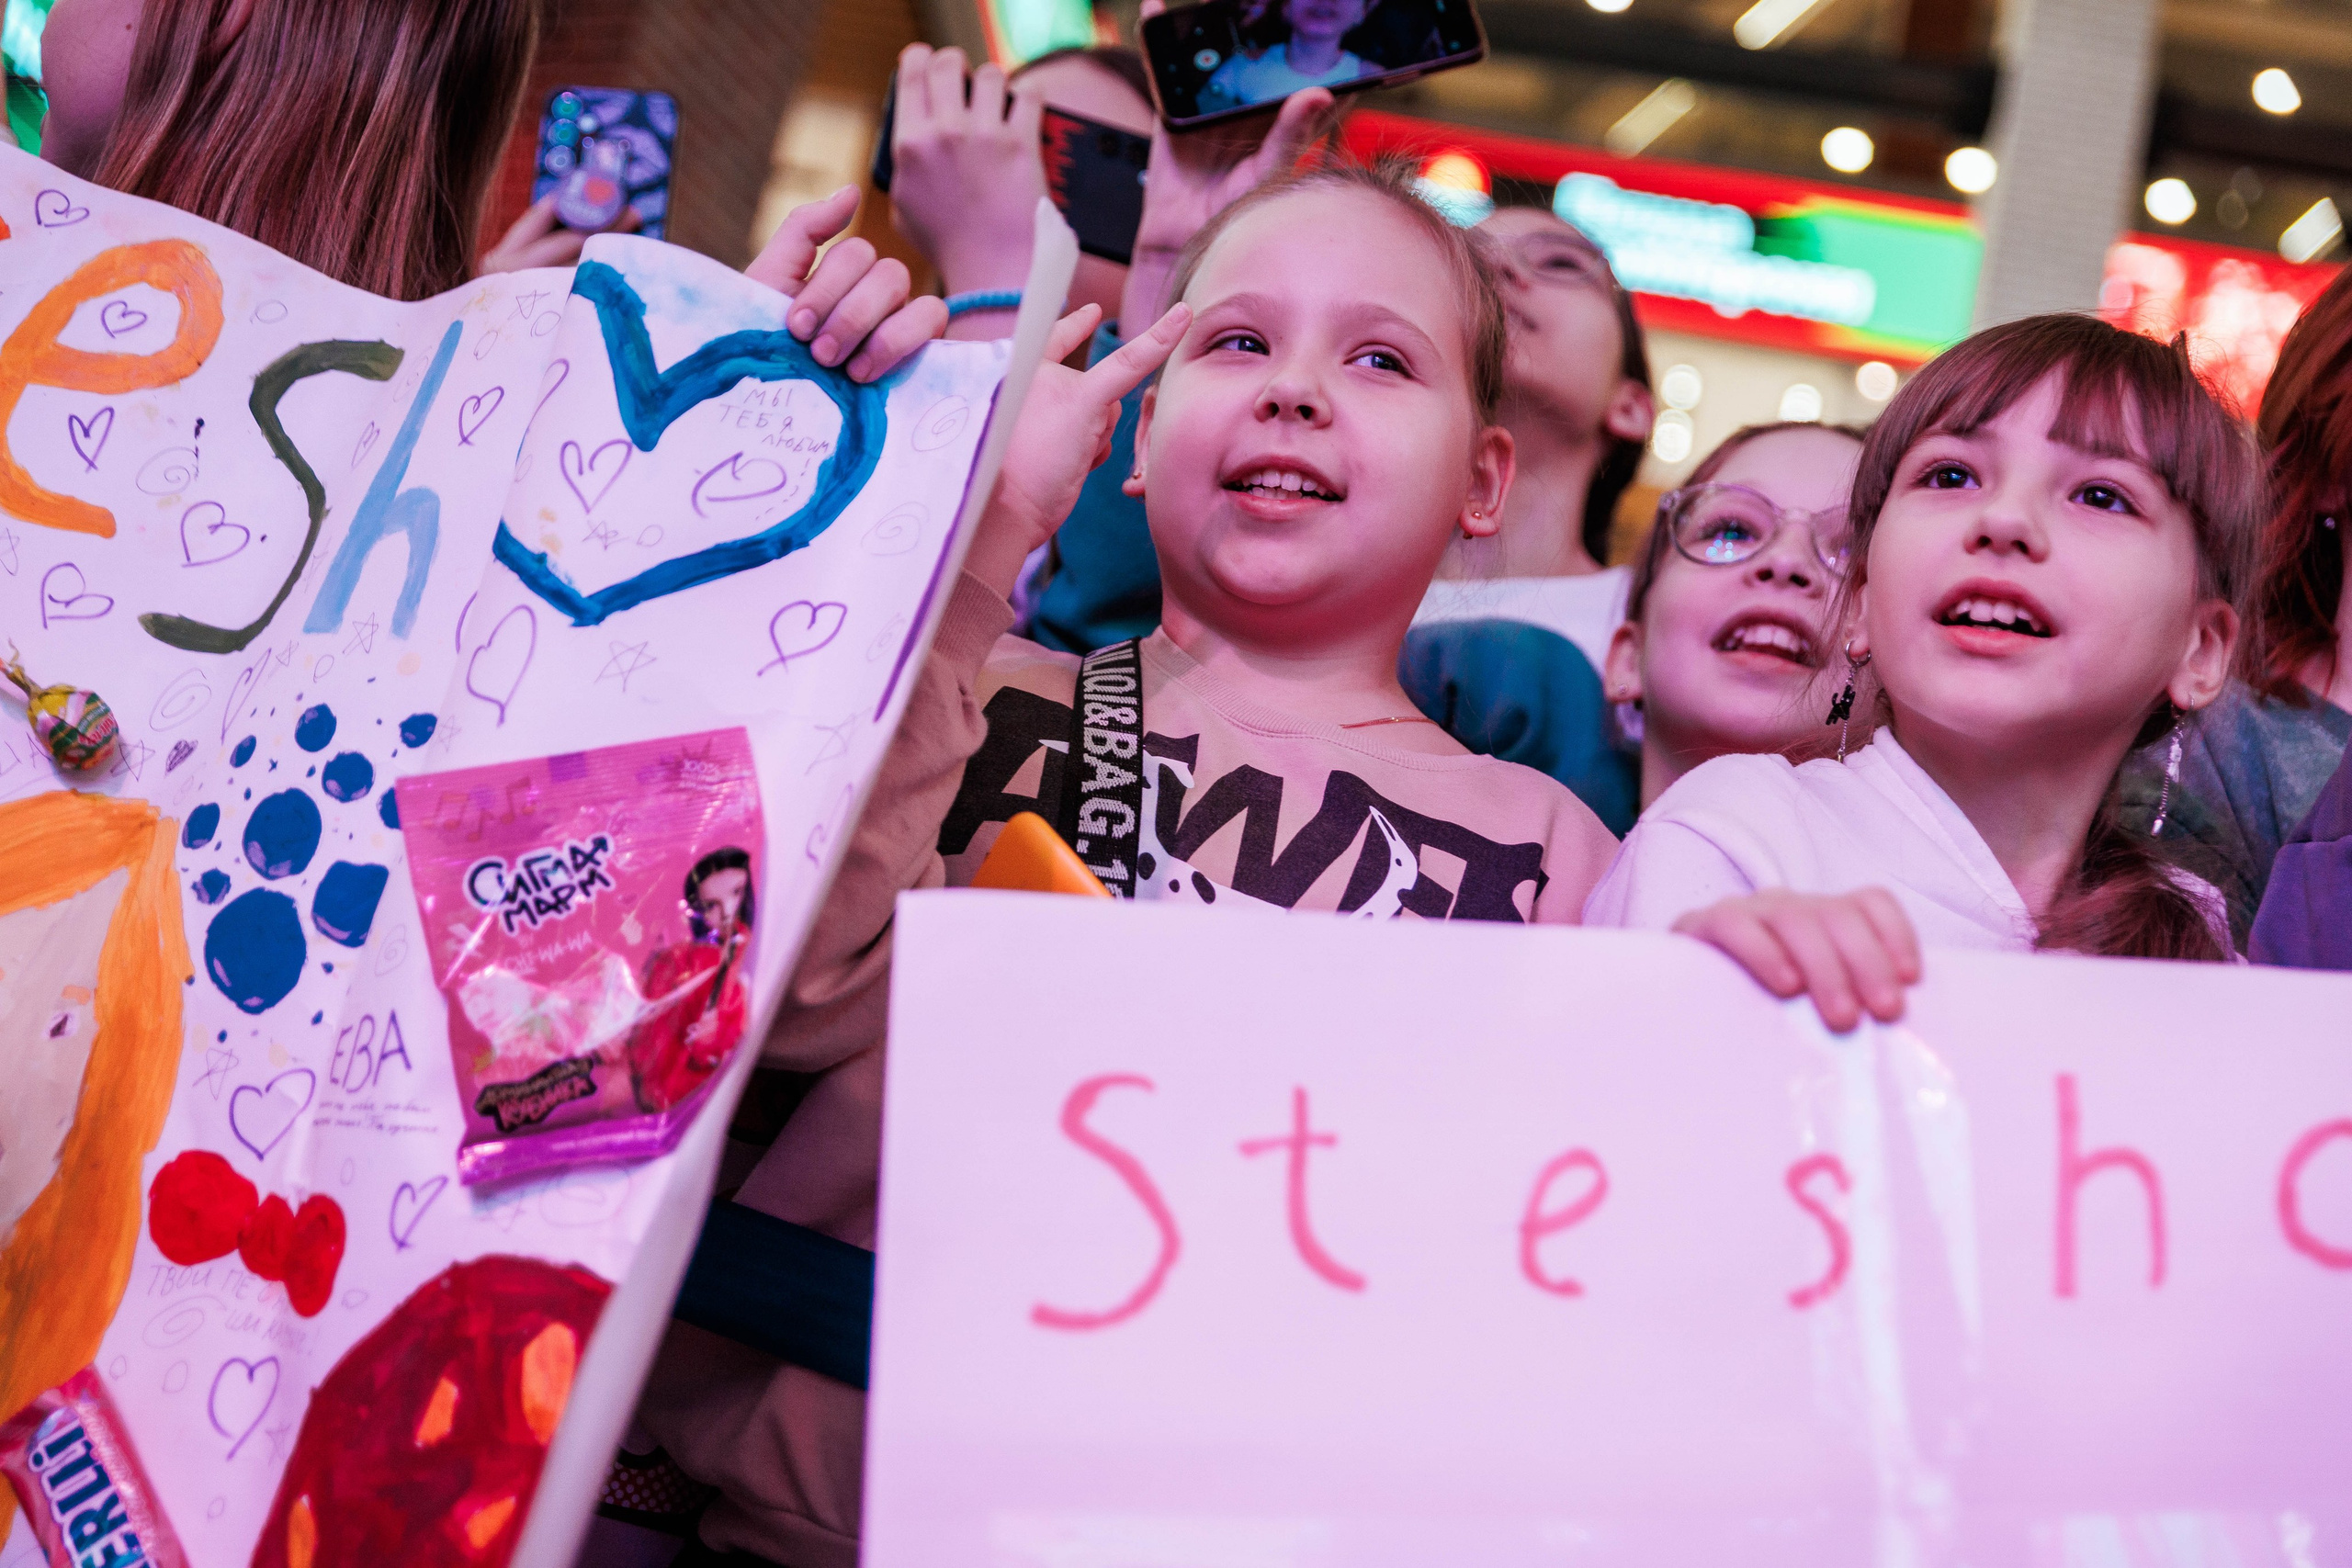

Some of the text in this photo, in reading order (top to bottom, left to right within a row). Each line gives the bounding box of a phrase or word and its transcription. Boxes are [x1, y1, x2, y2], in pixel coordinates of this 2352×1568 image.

[742, 387, 794, 408] МЫ
[718, 402, 795, 435] ТЕБЯ
[329, 1009, 413, 1094] ЕВА
